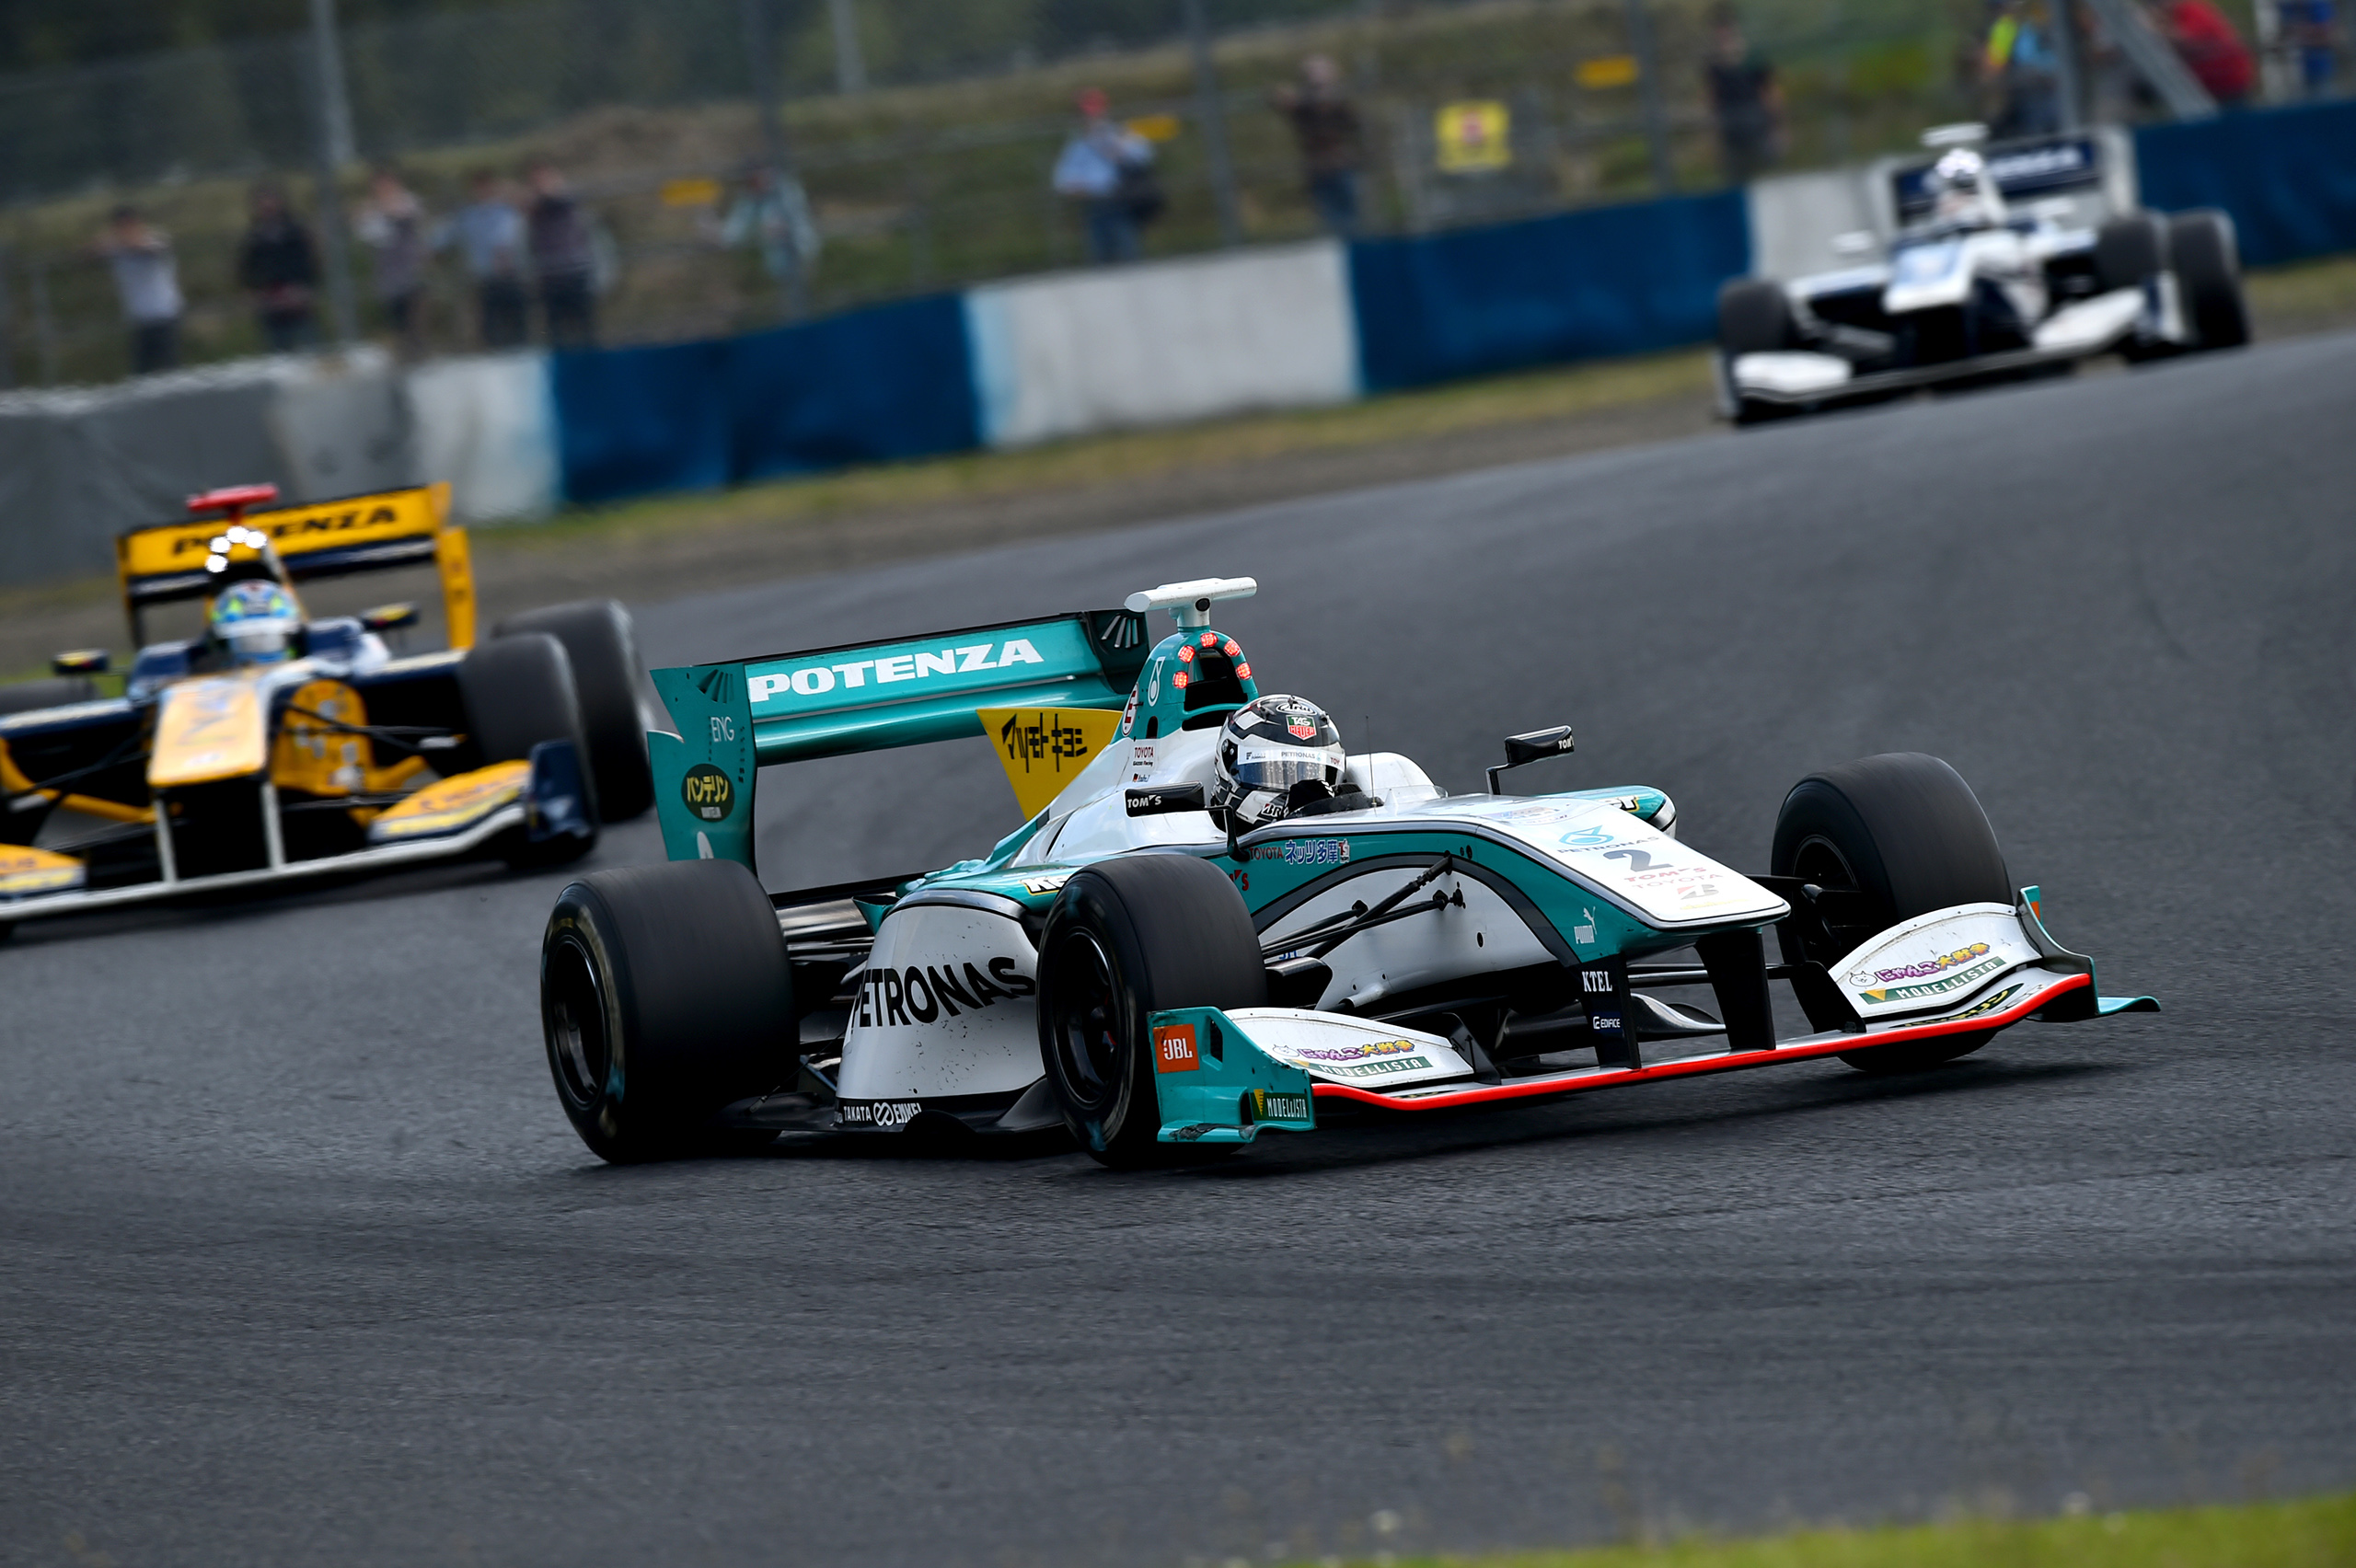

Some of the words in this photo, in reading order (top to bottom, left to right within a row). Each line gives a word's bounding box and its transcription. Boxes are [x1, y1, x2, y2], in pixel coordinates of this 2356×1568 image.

[748, 640, 1044, 703] POTENZA
[1291, 717, 1311, 726] TAG
[1290, 726, 1315, 739] HEUER
[1134, 746, 1154, 759] TOYOTA
[1280, 751, 1316, 759] PETRONAS
[687, 775, 729, 803] バンテリン
[1127, 795, 1162, 809] TOM'S
[1249, 847, 1284, 860] TOYOTA
[1285, 839, 1338, 865] ネッツ多摩
[1557, 836, 1660, 854] PETRONAS
[1602, 848, 1674, 872] 2
[1623, 867, 1707, 882] TOM'S
[1631, 872, 1724, 890] TOYOTA
[1875, 941, 1991, 983] にゃんこ大戦争
[1581, 971, 1612, 992] KTEL
[1896, 961, 1998, 999] MODELLISTA
[1600, 1018, 1621, 1029] EDIFICE
[1164, 1038, 1193, 1060] JBL
[1297, 1039, 1415, 1063] にゃんこ大戦争
[1319, 1058, 1424, 1078] MODELLISTA
[843, 1106, 872, 1122] TAKATA
[1266, 1098, 1308, 1119] MODELLISTA
